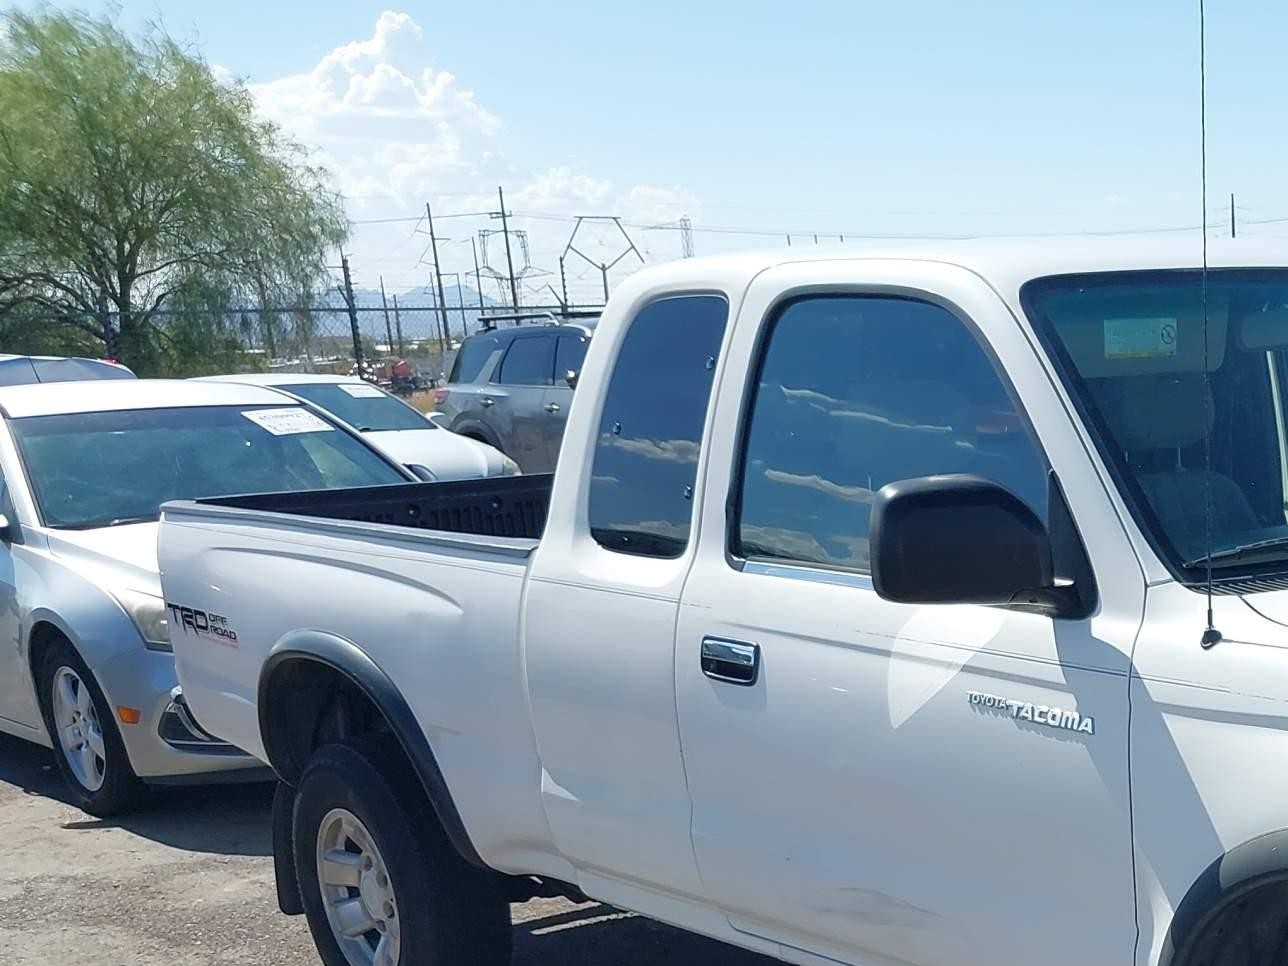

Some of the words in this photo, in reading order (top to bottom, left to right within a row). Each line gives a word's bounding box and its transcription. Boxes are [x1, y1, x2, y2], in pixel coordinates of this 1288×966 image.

[167, 602, 209, 636] TRD
[208, 613, 228, 626] OFF
[210, 625, 237, 641] ROAD
[966, 690, 1008, 710] TOYOTA
[1007, 700, 1095, 735] TACOMA
